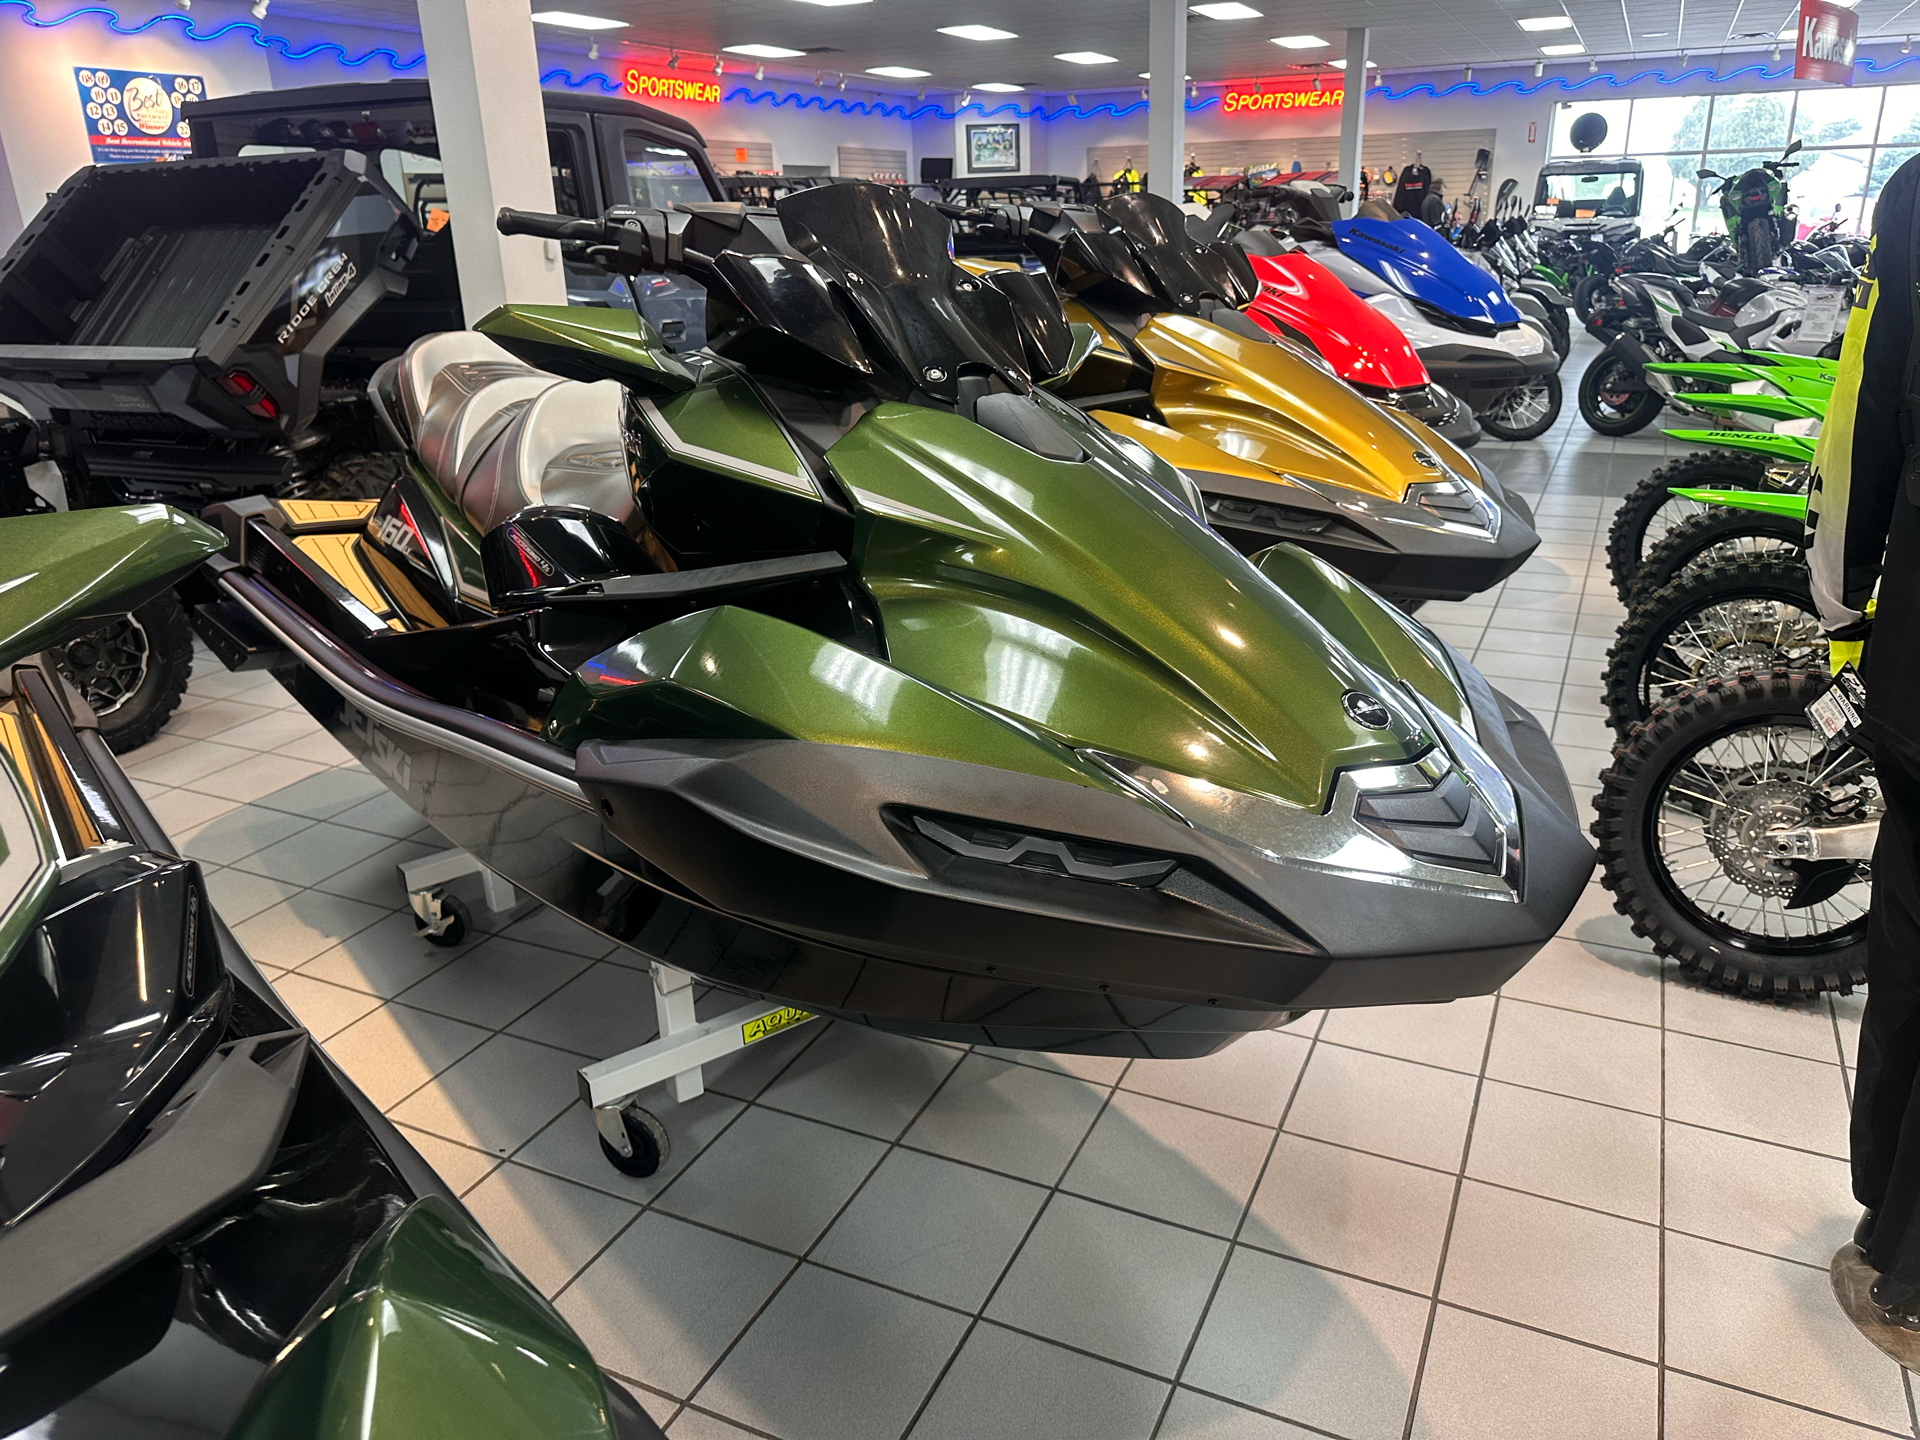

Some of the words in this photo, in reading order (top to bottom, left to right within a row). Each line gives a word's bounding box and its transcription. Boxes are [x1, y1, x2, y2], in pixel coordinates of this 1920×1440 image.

[126, 87, 162, 121] Best
[1348, 227, 1406, 254] Kawasaki
[277, 295, 318, 344] RIDGE
[317, 252, 348, 294] CREW
[1706, 431, 1780, 441] DUNLOP
[1837, 692, 1859, 724] WARNING
